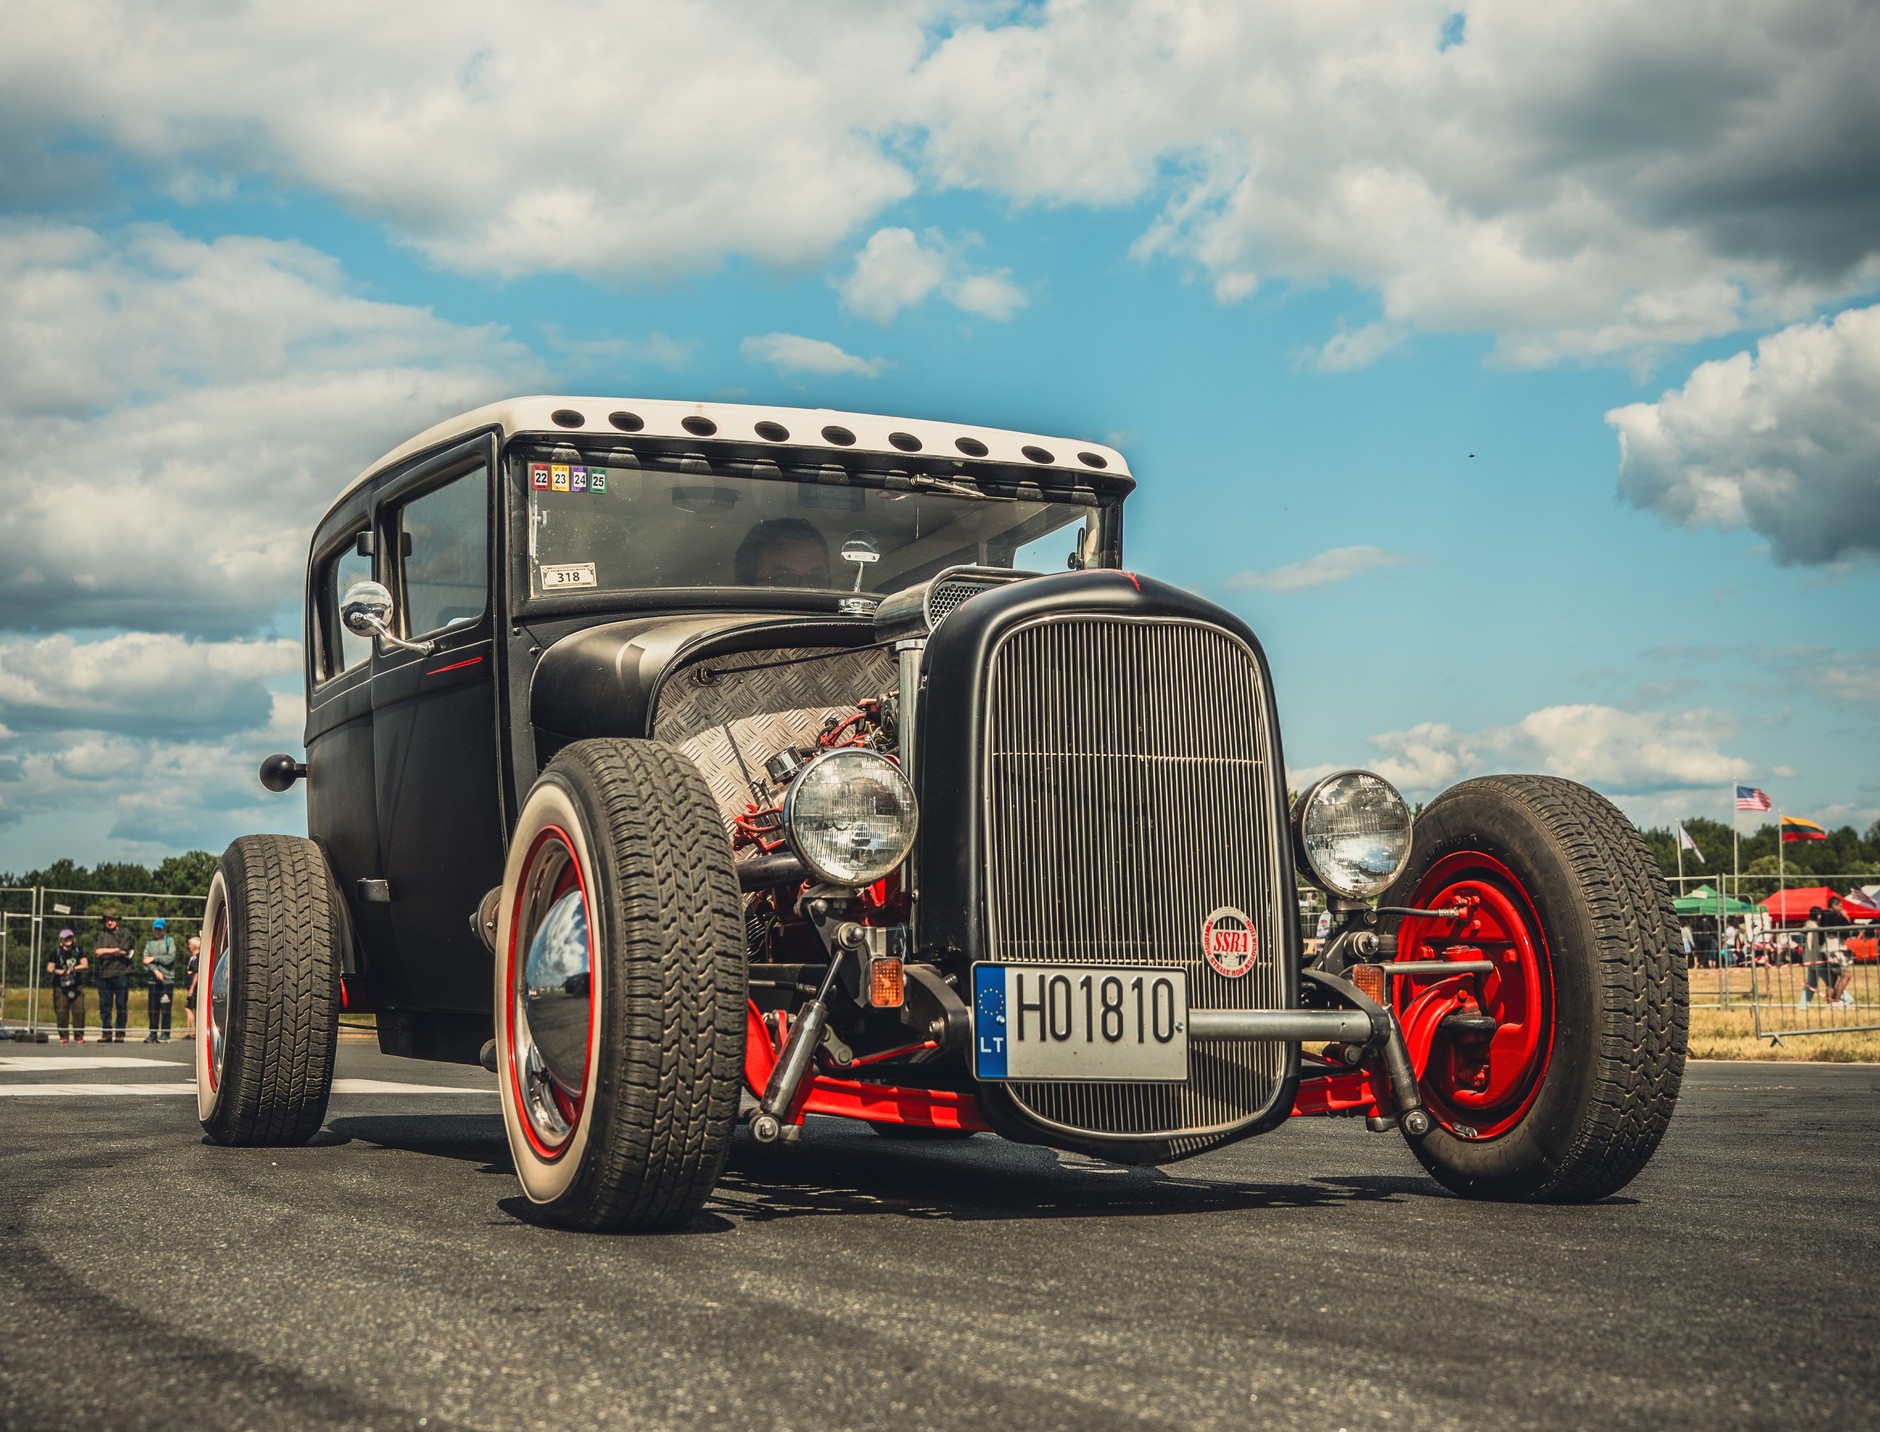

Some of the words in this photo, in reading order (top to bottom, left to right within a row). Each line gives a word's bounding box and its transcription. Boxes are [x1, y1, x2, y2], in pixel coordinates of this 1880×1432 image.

[535, 472, 547, 483] 22
[554, 473, 566, 485] 23
[574, 474, 586, 485] 24
[592, 475, 604, 487] 25
[557, 571, 580, 583] 318
[1213, 931, 1248, 953] SSRA
[1210, 957, 1231, 976] STREET
[1231, 968, 1245, 977] ROD
[1244, 920, 1258, 970] ASSOCIATION
[1016, 972, 1175, 1044] H01810
[980, 1036, 1004, 1053] LT
